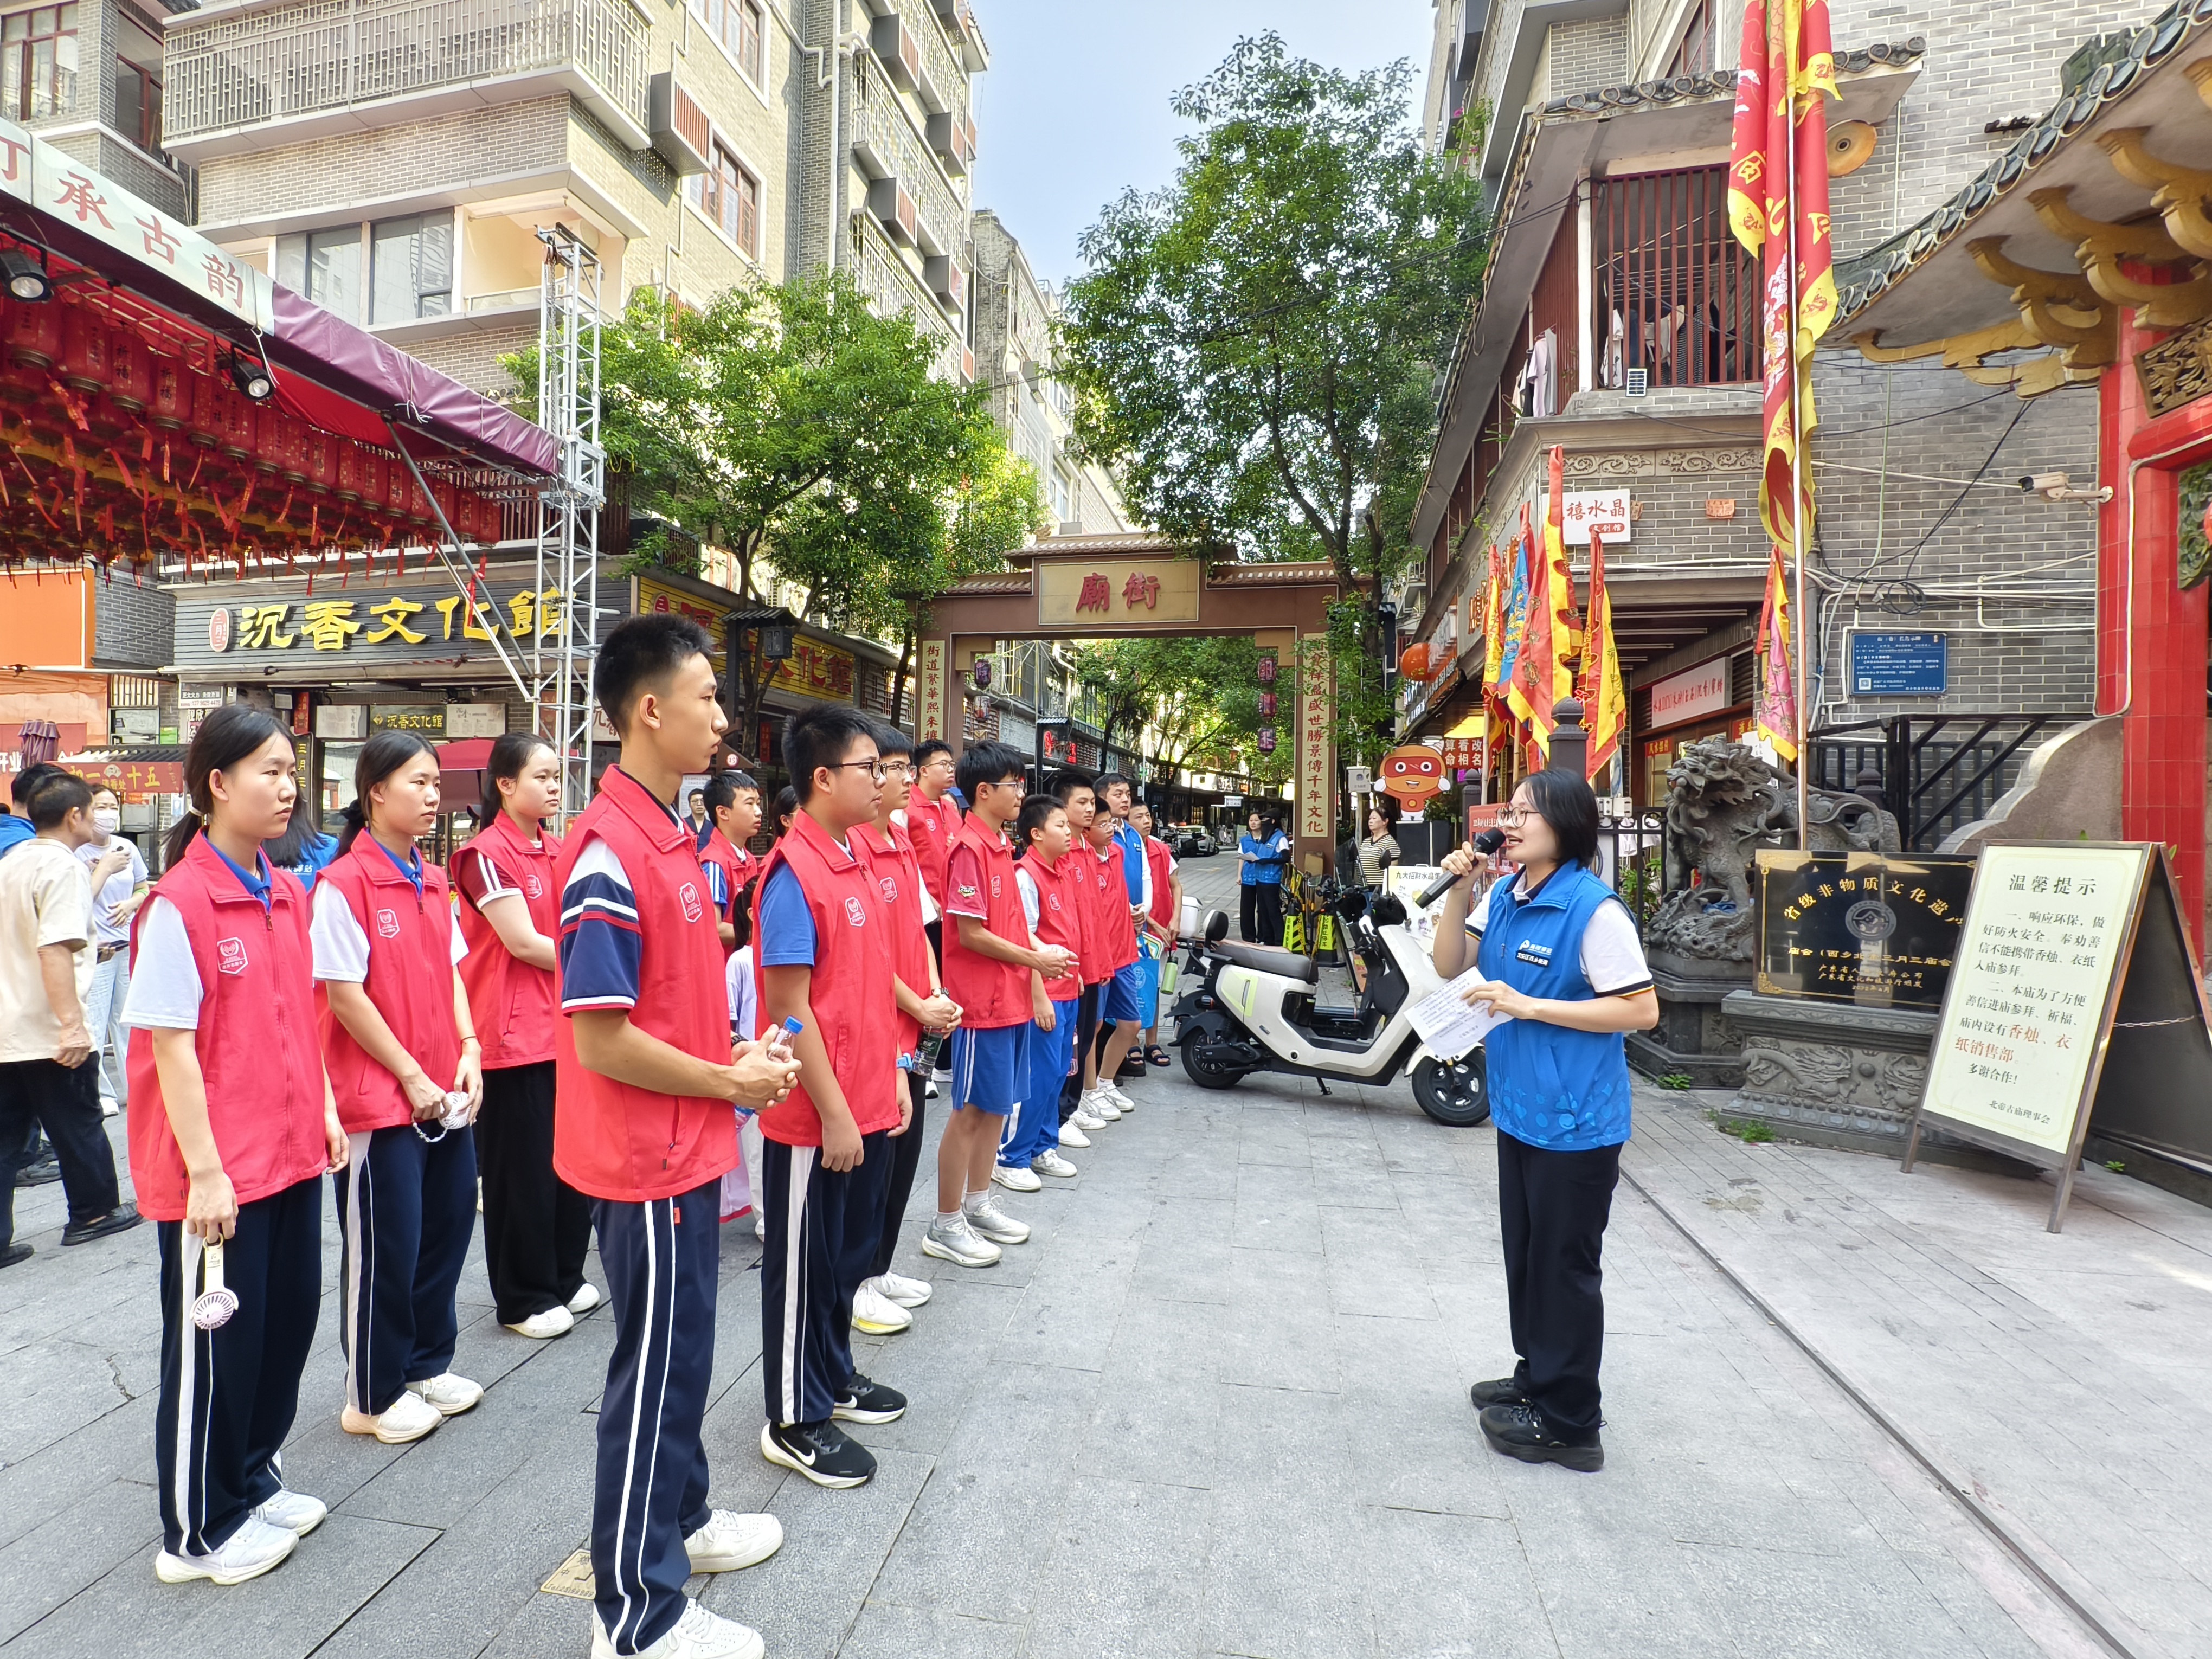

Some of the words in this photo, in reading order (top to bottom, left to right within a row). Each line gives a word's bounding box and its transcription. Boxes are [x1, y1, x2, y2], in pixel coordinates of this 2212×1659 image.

[1562, 498, 1625, 520] 禧水晶
[1076, 572, 1161, 613] 廟街
[240, 587, 577, 650] 沉香文化館
[387, 713, 454, 729] 沉香文化館
[126, 765, 160, 790] 十五
[2009, 874, 2097, 896] 温馨提示
